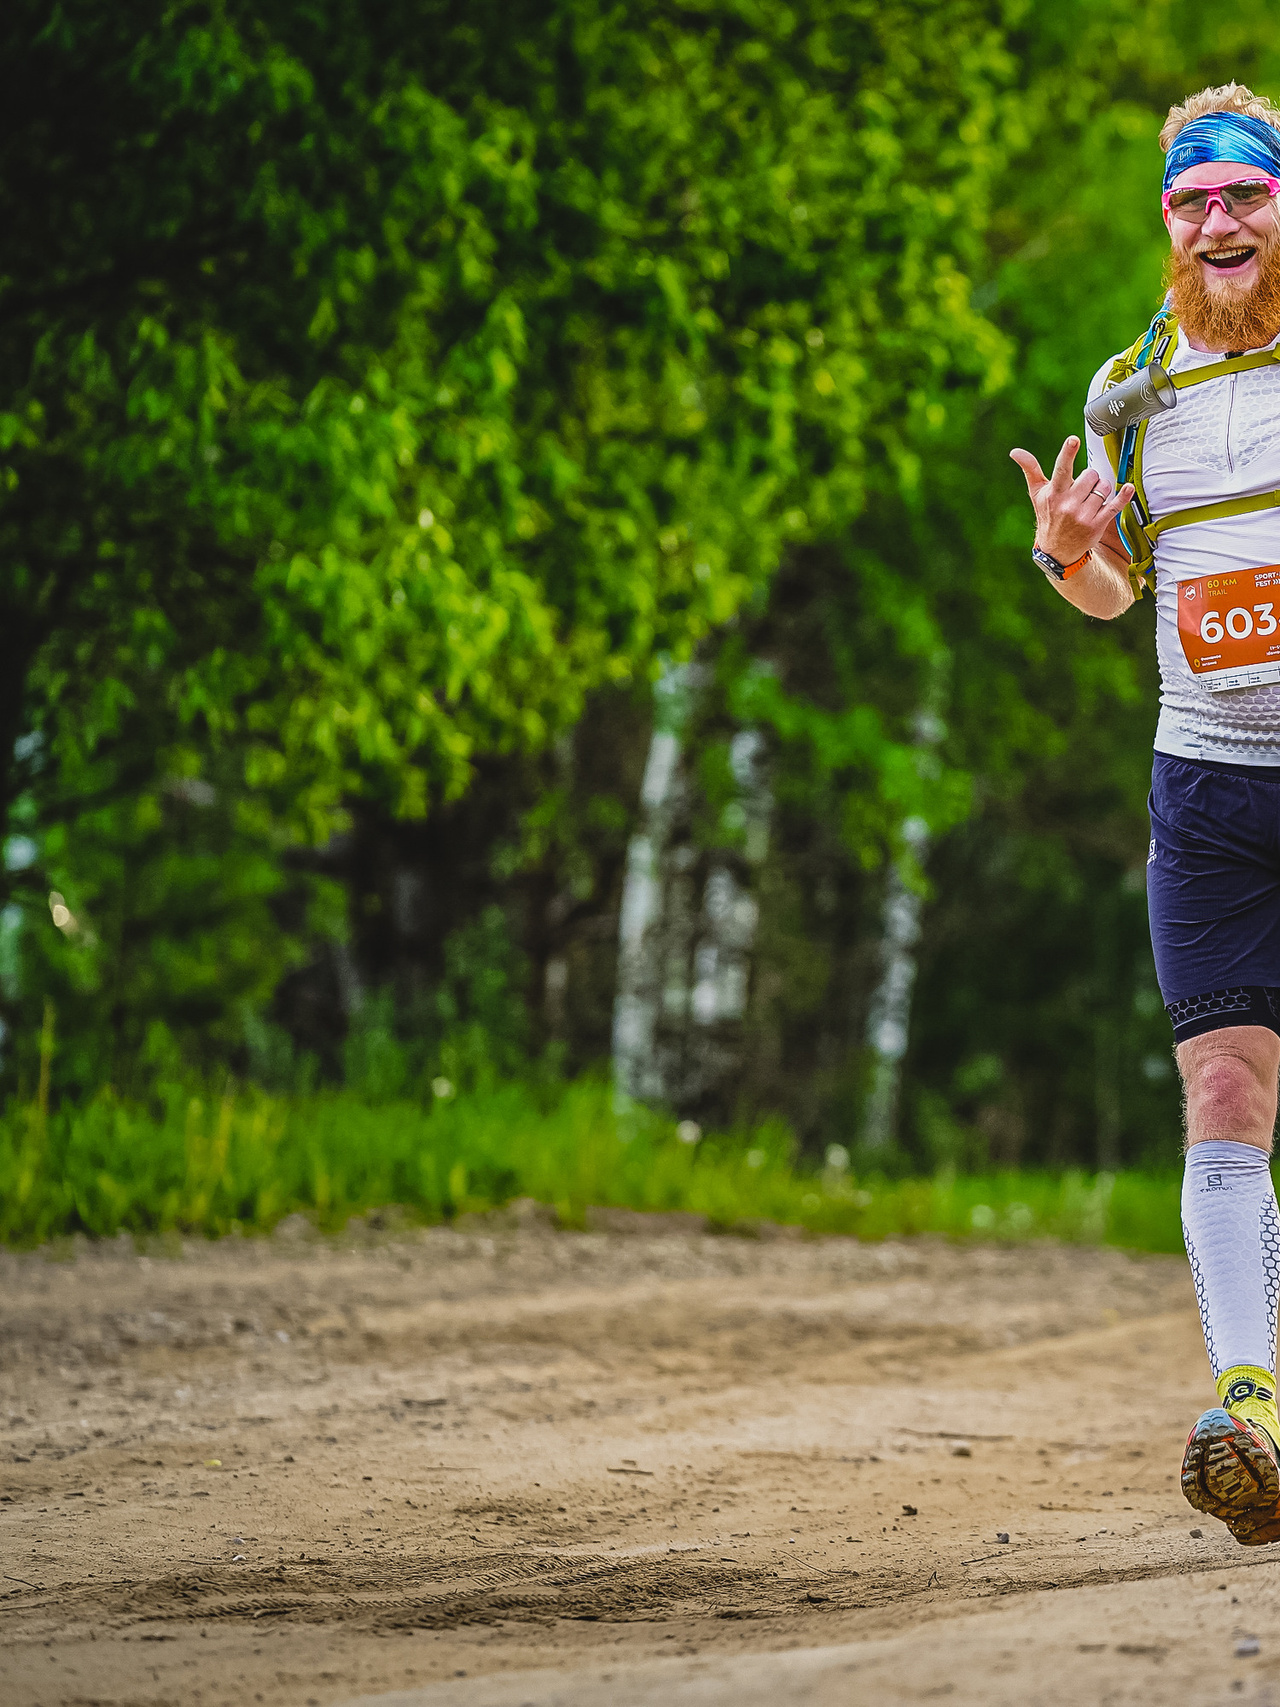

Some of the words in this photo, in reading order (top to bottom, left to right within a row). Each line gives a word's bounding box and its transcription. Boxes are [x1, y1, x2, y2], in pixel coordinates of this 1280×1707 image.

[1207, 580, 1220, 589] 60
[1222, 578, 1237, 587] KM
[1255, 579, 1272, 588] FEST
[1208, 589, 1228, 597] TRAIL
